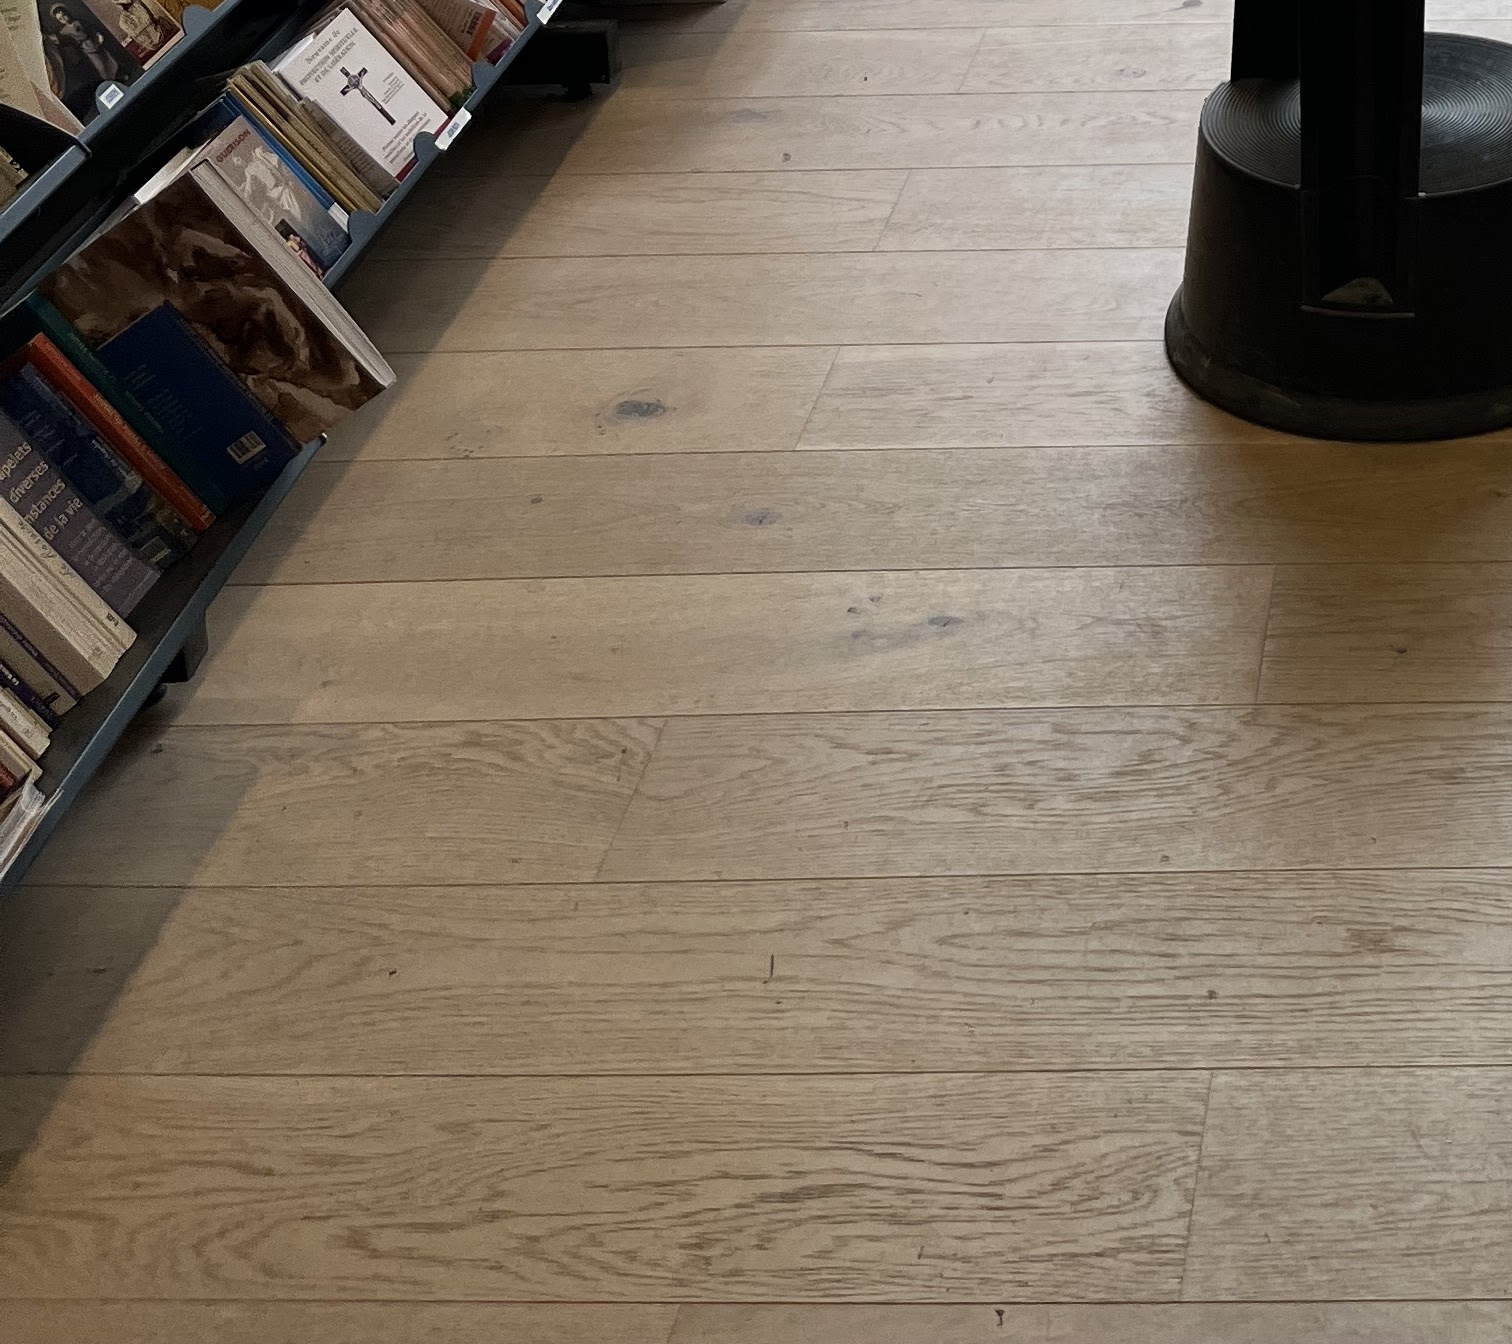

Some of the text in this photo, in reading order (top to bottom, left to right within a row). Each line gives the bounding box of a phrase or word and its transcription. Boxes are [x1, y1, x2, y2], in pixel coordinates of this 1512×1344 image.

[9, 461, 49, 504] diverses
[44, 521, 59, 541] de
[65, 496, 84, 519] vie
